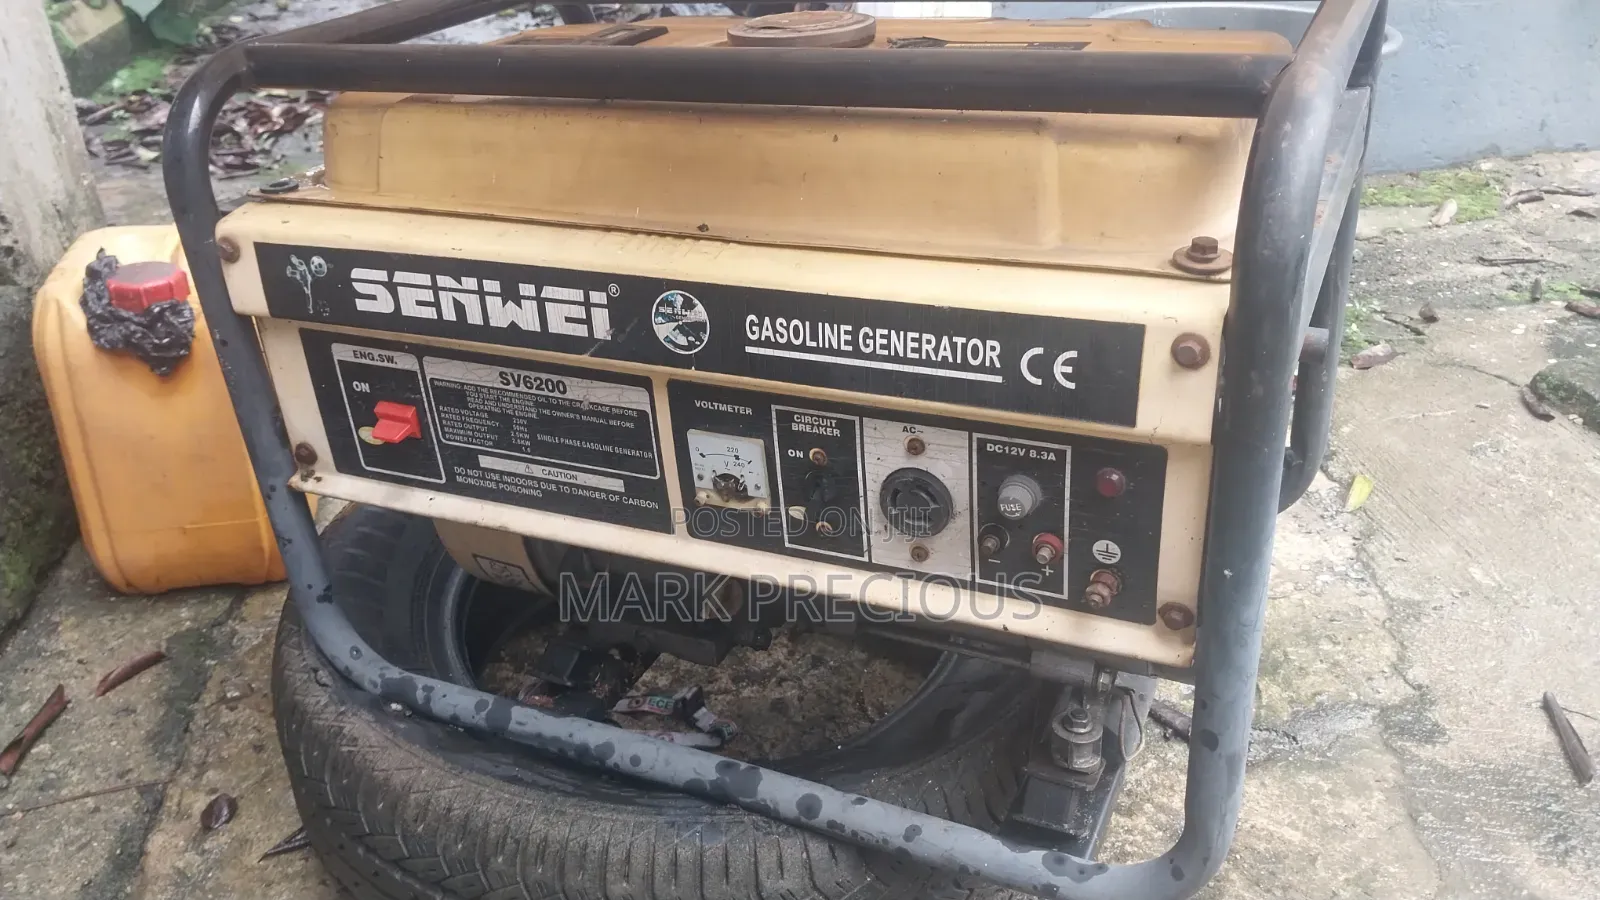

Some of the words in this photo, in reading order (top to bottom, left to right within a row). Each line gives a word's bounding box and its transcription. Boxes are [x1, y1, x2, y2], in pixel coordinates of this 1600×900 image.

[745, 313, 853, 352] GASOLINE
[858, 326, 1002, 369] GENERATOR
[352, 349, 398, 365] ENG.SW.
[1020, 346, 1078, 389] CE
[352, 380, 371, 393] ON
[498, 370, 567, 396] SV6200
[464, 384, 476, 392] ADD
[479, 386, 489, 394] THE
[489, 388, 537, 401] RECOMMENDED
[537, 395, 548, 403] OIL
[559, 399, 571, 407] THE
[612, 407, 638, 418] BEFORE
[465, 390, 478, 398] YOU
[479, 393, 497, 401] START
[501, 395, 511, 403] THE
[439, 405, 460, 414] RATED
[461, 408, 489, 419] VOLTAGE
[467, 396, 483, 404] READ
[484, 399, 497, 407] AND
[498, 400, 538, 413] UNDERSTAND
[539, 408, 551, 416] THE
[551, 409, 581, 420] OWNER'S
[581, 415, 608, 425] MANUAL
[609, 418, 635, 429] BEFORE
[468, 403, 501, 413] OPERATING
[503, 408, 514, 416] THE
[694, 399, 753, 416] VOLTMETER
[440, 412, 461, 421] RATED
[462, 415, 500, 427] FREQUENCY
[442, 419, 463, 428] RATED
[463, 422, 488, 432] OUTPUT
[793, 414, 837, 428] CIRCUIT
[791, 422, 841, 437] BREAKER
[444, 426, 473, 437] MAXIMUM
[474, 430, 499, 440] OUTPUT
[536, 433, 560, 444] SINGLE
[560, 437, 581, 448] PHASE
[581, 440, 614, 453] GASOLINE
[614, 446, 653, 459] GENERATOR
[445, 433, 470, 443] POWER
[470, 436, 494, 446] FACTOR
[726, 446, 739, 454] 220
[787, 449, 804, 459] ON
[986, 442, 1026, 458] DC12V
[1029, 449, 1057, 462] 8.3A
[541, 468, 579, 482] CAUTION
[454, 466, 465, 475] DO
[467, 468, 484, 478] NOT
[485, 471, 501, 481] USE
[502, 474, 539, 488] INDOORS
[540, 481, 558, 493] DUE
[560, 484, 570, 494] TO
[571, 487, 608, 501] DANGER
[608, 494, 621, 503] OF
[622, 496, 660, 510] CARBON
[455, 475, 498, 490] MONOXIDE
[499, 482, 543, 498] POISONING
[1000, 502, 1023, 513] FUSE
